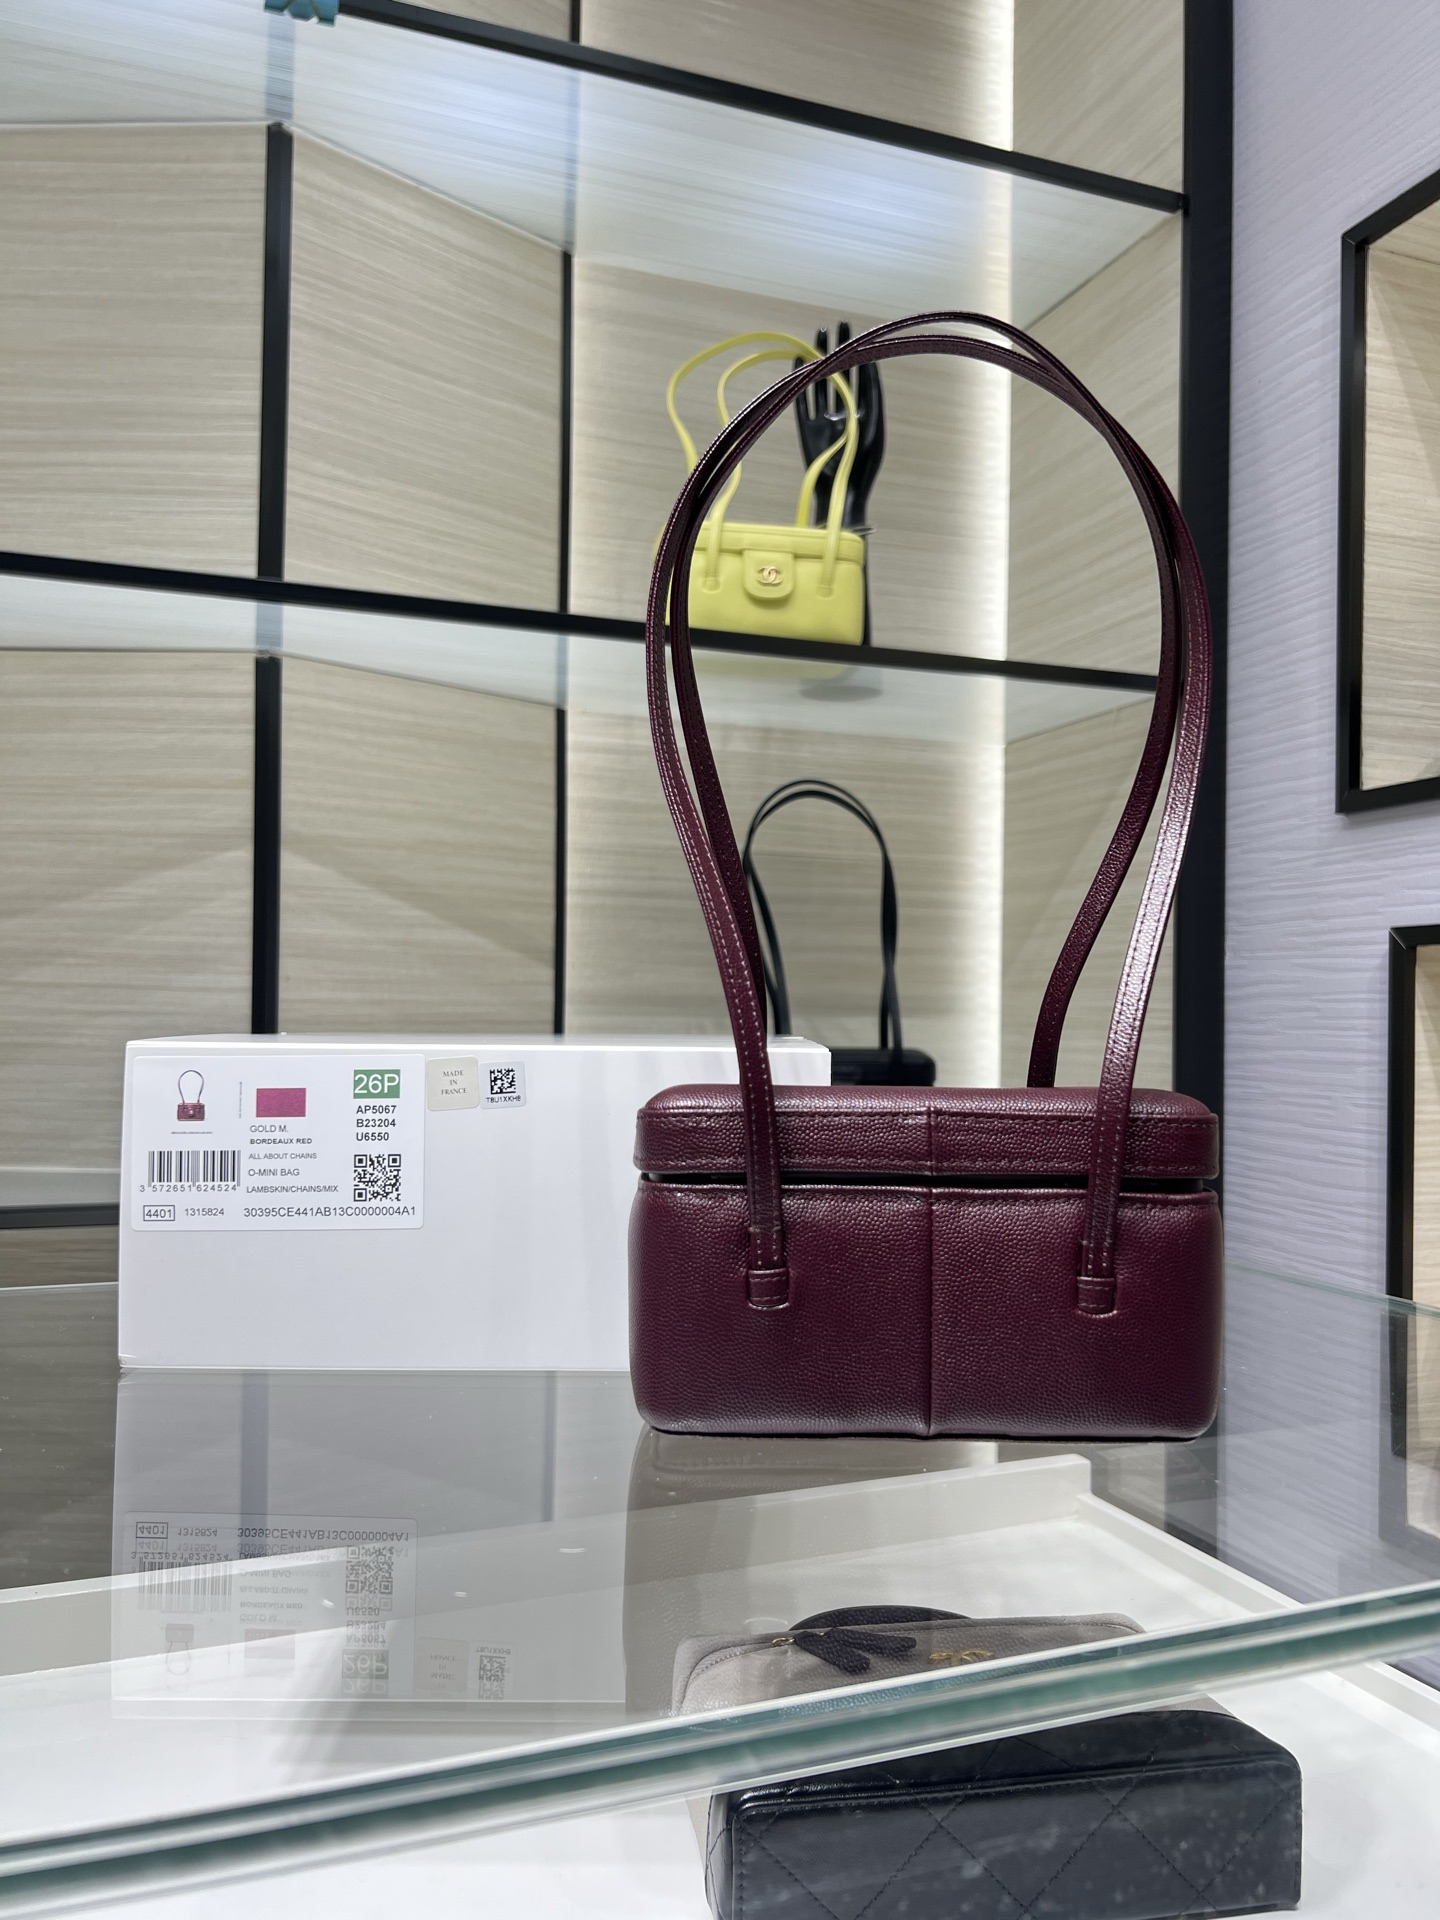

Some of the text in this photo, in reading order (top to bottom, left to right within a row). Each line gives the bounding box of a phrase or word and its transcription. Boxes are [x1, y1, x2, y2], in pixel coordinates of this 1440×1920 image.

[443, 1069, 464, 1077] MADE
[354, 1073, 400, 1094] 26P
[441, 1087, 467, 1095] FRANCE
[356, 1105, 397, 1114] AP5067
[356, 1118, 397, 1128] B23204
[250, 1125, 276, 1133] GOLD
[356, 1132, 390, 1141] U6550
[248, 1168, 300, 1177] O-MINI BAG
[246, 1185, 339, 1194] LAMBSKIN/CHAINS/MIX
[145, 1208, 172, 1218] 4401
[184, 1207, 225, 1217] 1315824
[243, 1206, 416, 1218] 30395CE441AB13C0000004A1
